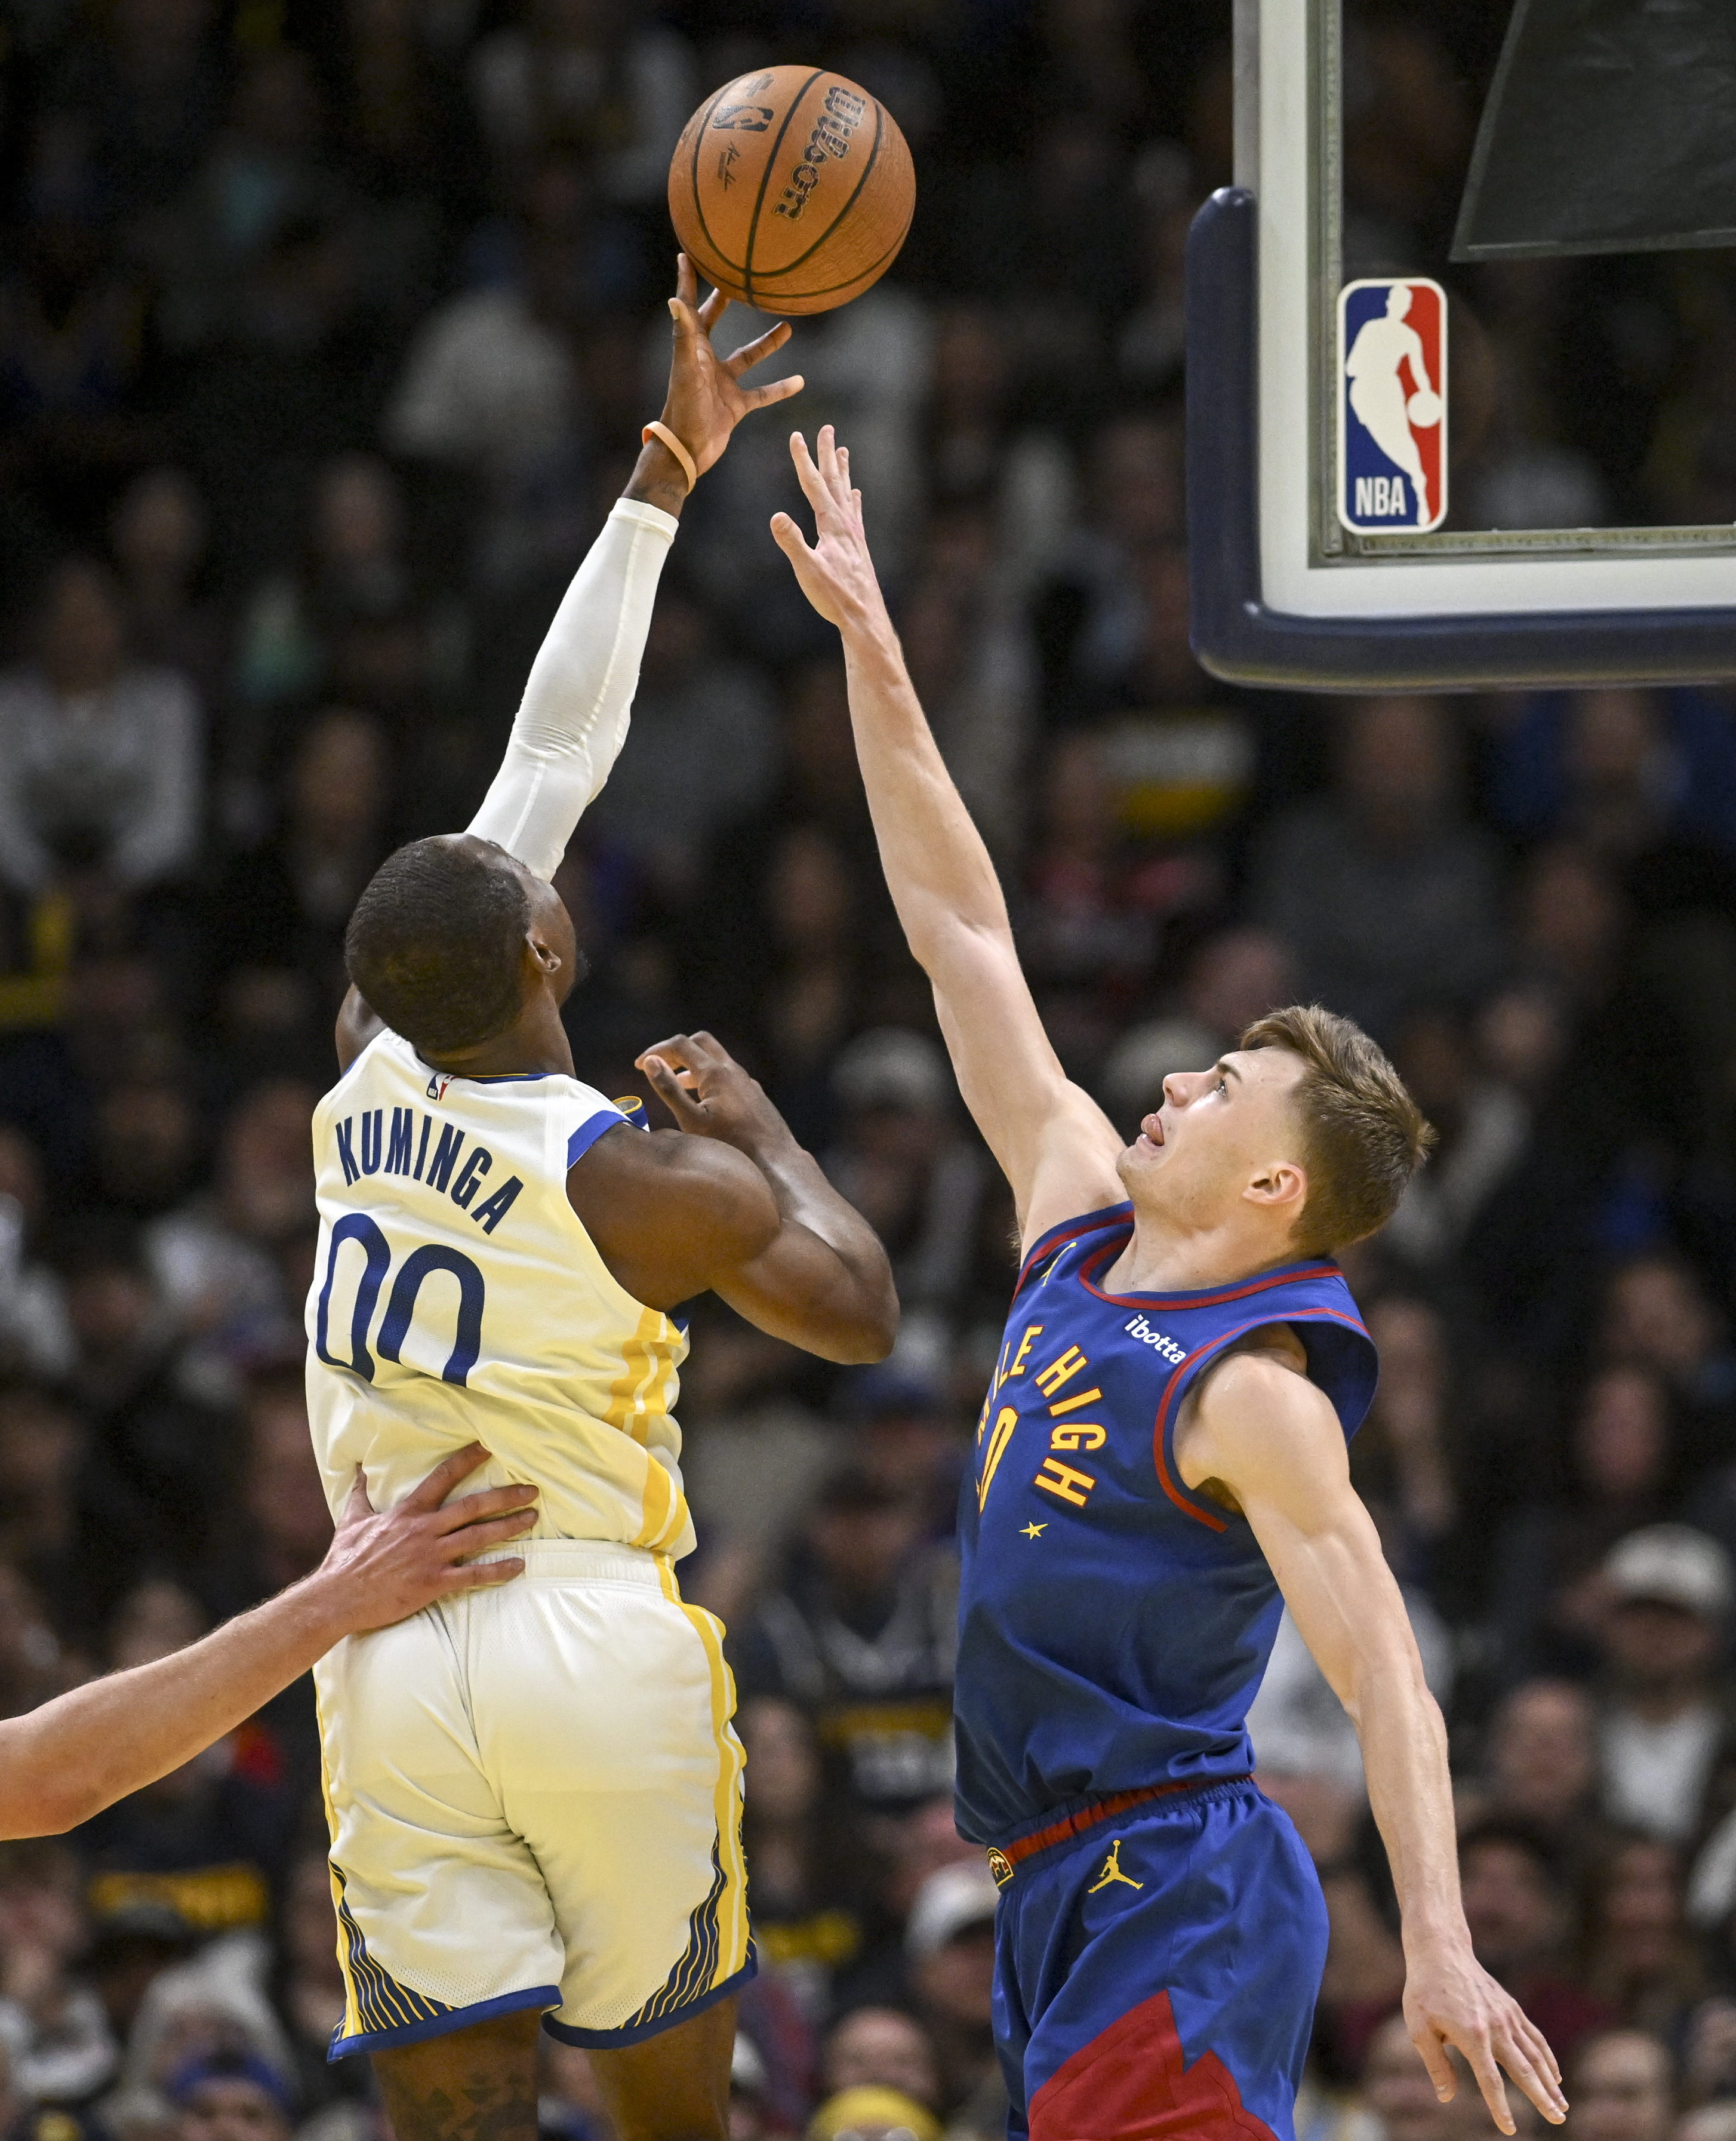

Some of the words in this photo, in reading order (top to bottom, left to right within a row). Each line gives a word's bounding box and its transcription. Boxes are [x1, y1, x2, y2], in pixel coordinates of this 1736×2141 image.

[774, 86, 866, 220] Wilson
[1356, 476, 1406, 516] NBA
[427, 1087, 438, 1097] NBA
[335, 1106, 524, 1235] KUMINGA
[316, 1213, 485, 1388] 00
[1125, 1314, 1186, 1364] ibotta
[1035, 1344, 1107, 1508] HIGH
